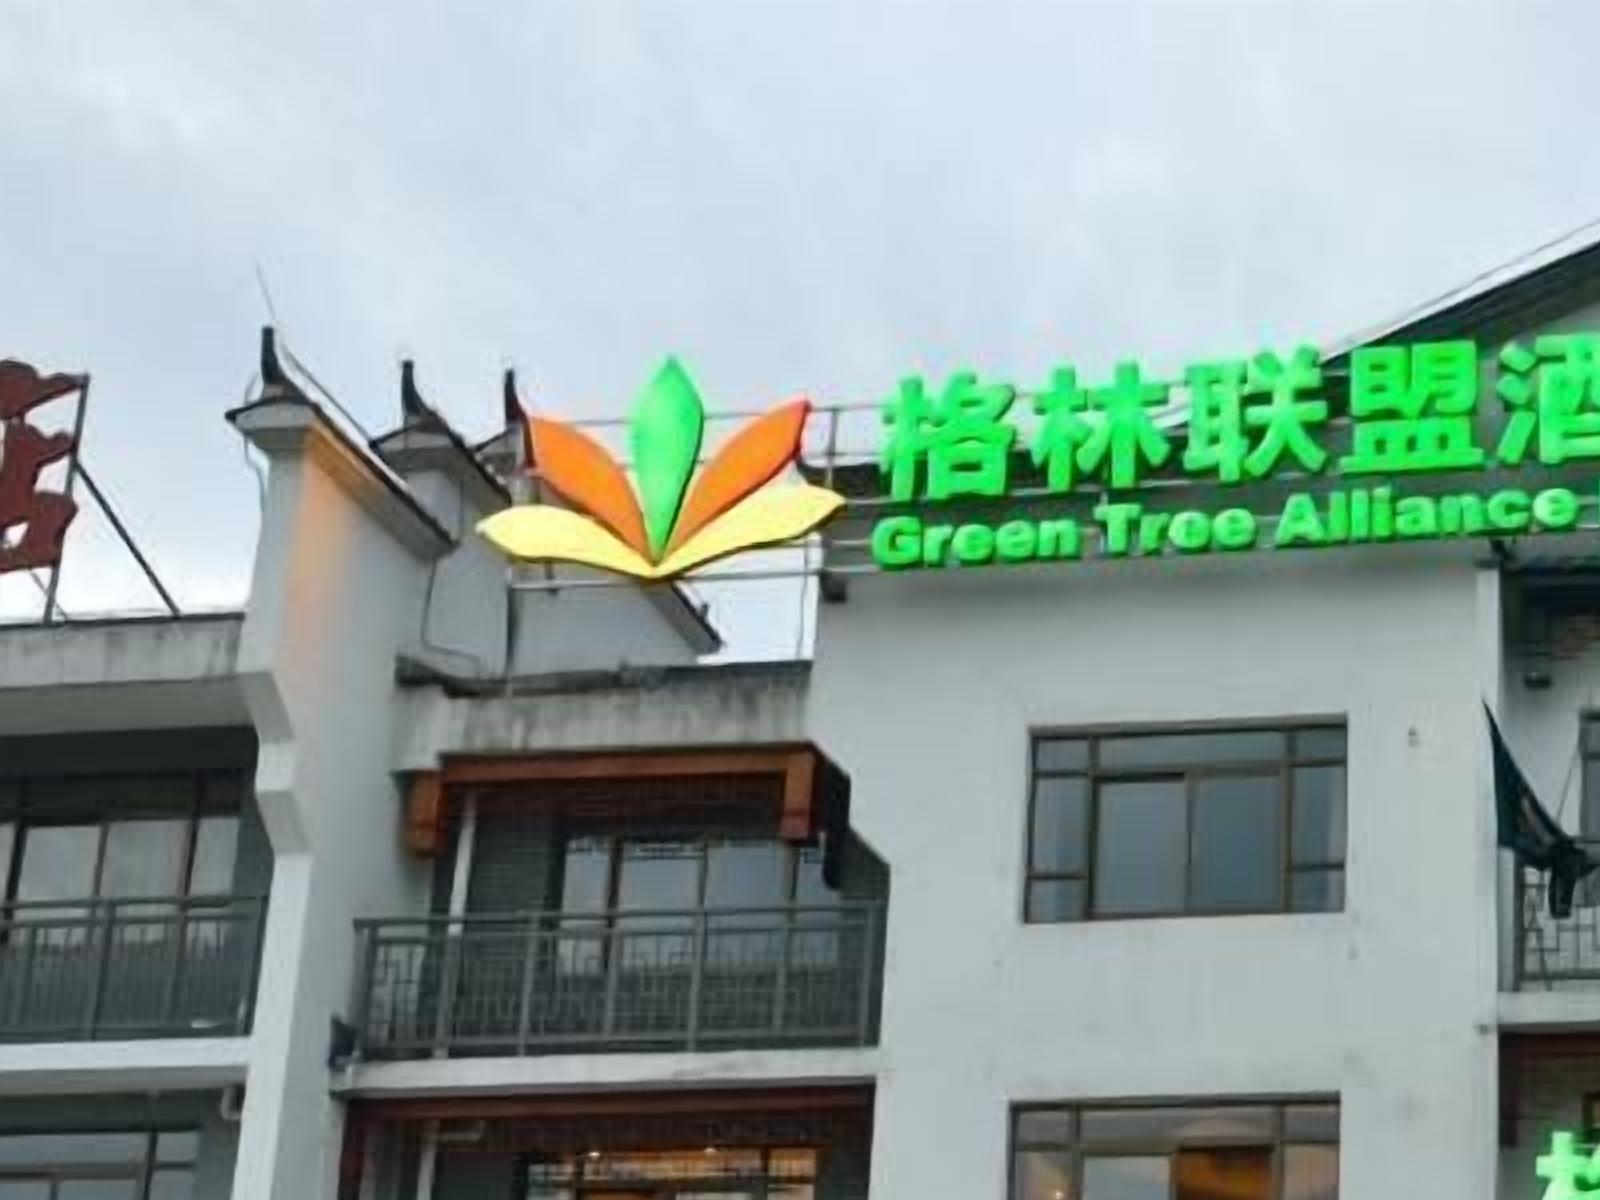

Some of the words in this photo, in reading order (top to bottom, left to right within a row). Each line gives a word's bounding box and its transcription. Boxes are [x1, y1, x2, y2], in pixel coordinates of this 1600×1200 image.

[870, 515, 1082, 570] Green
[1094, 499, 1258, 556] Tree
[1274, 487, 1581, 549] Alliance
